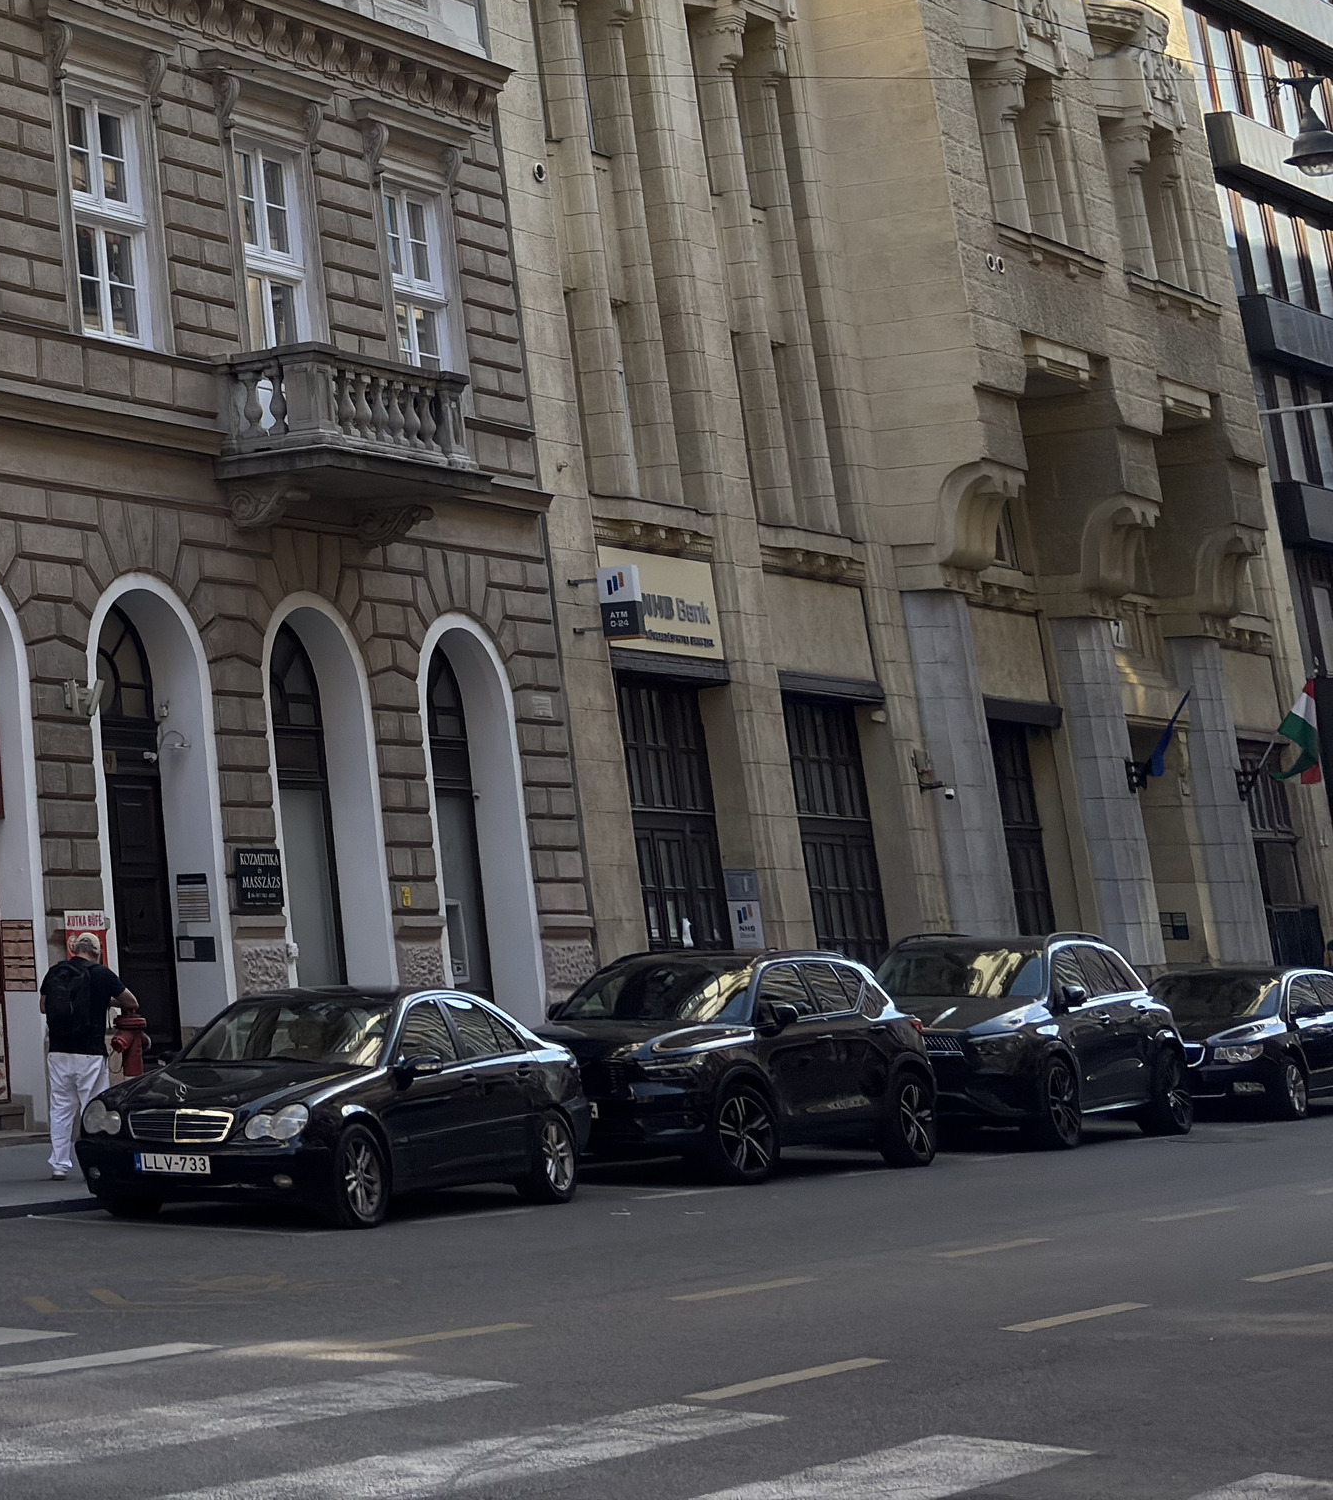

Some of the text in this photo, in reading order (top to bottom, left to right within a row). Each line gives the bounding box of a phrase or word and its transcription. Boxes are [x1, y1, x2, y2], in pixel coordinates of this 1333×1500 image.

[610, 611, 628, 619] ATM
[641, 592, 711, 625] NHB Bank
[610, 619, 629, 627] 0-24
[240, 853, 279, 866] KOZMETIKA
[242, 872, 281, 889] MASSZÁZS
[67, 915, 87, 926] KUTKA
[144, 1154, 207, 1171] LLV-733
